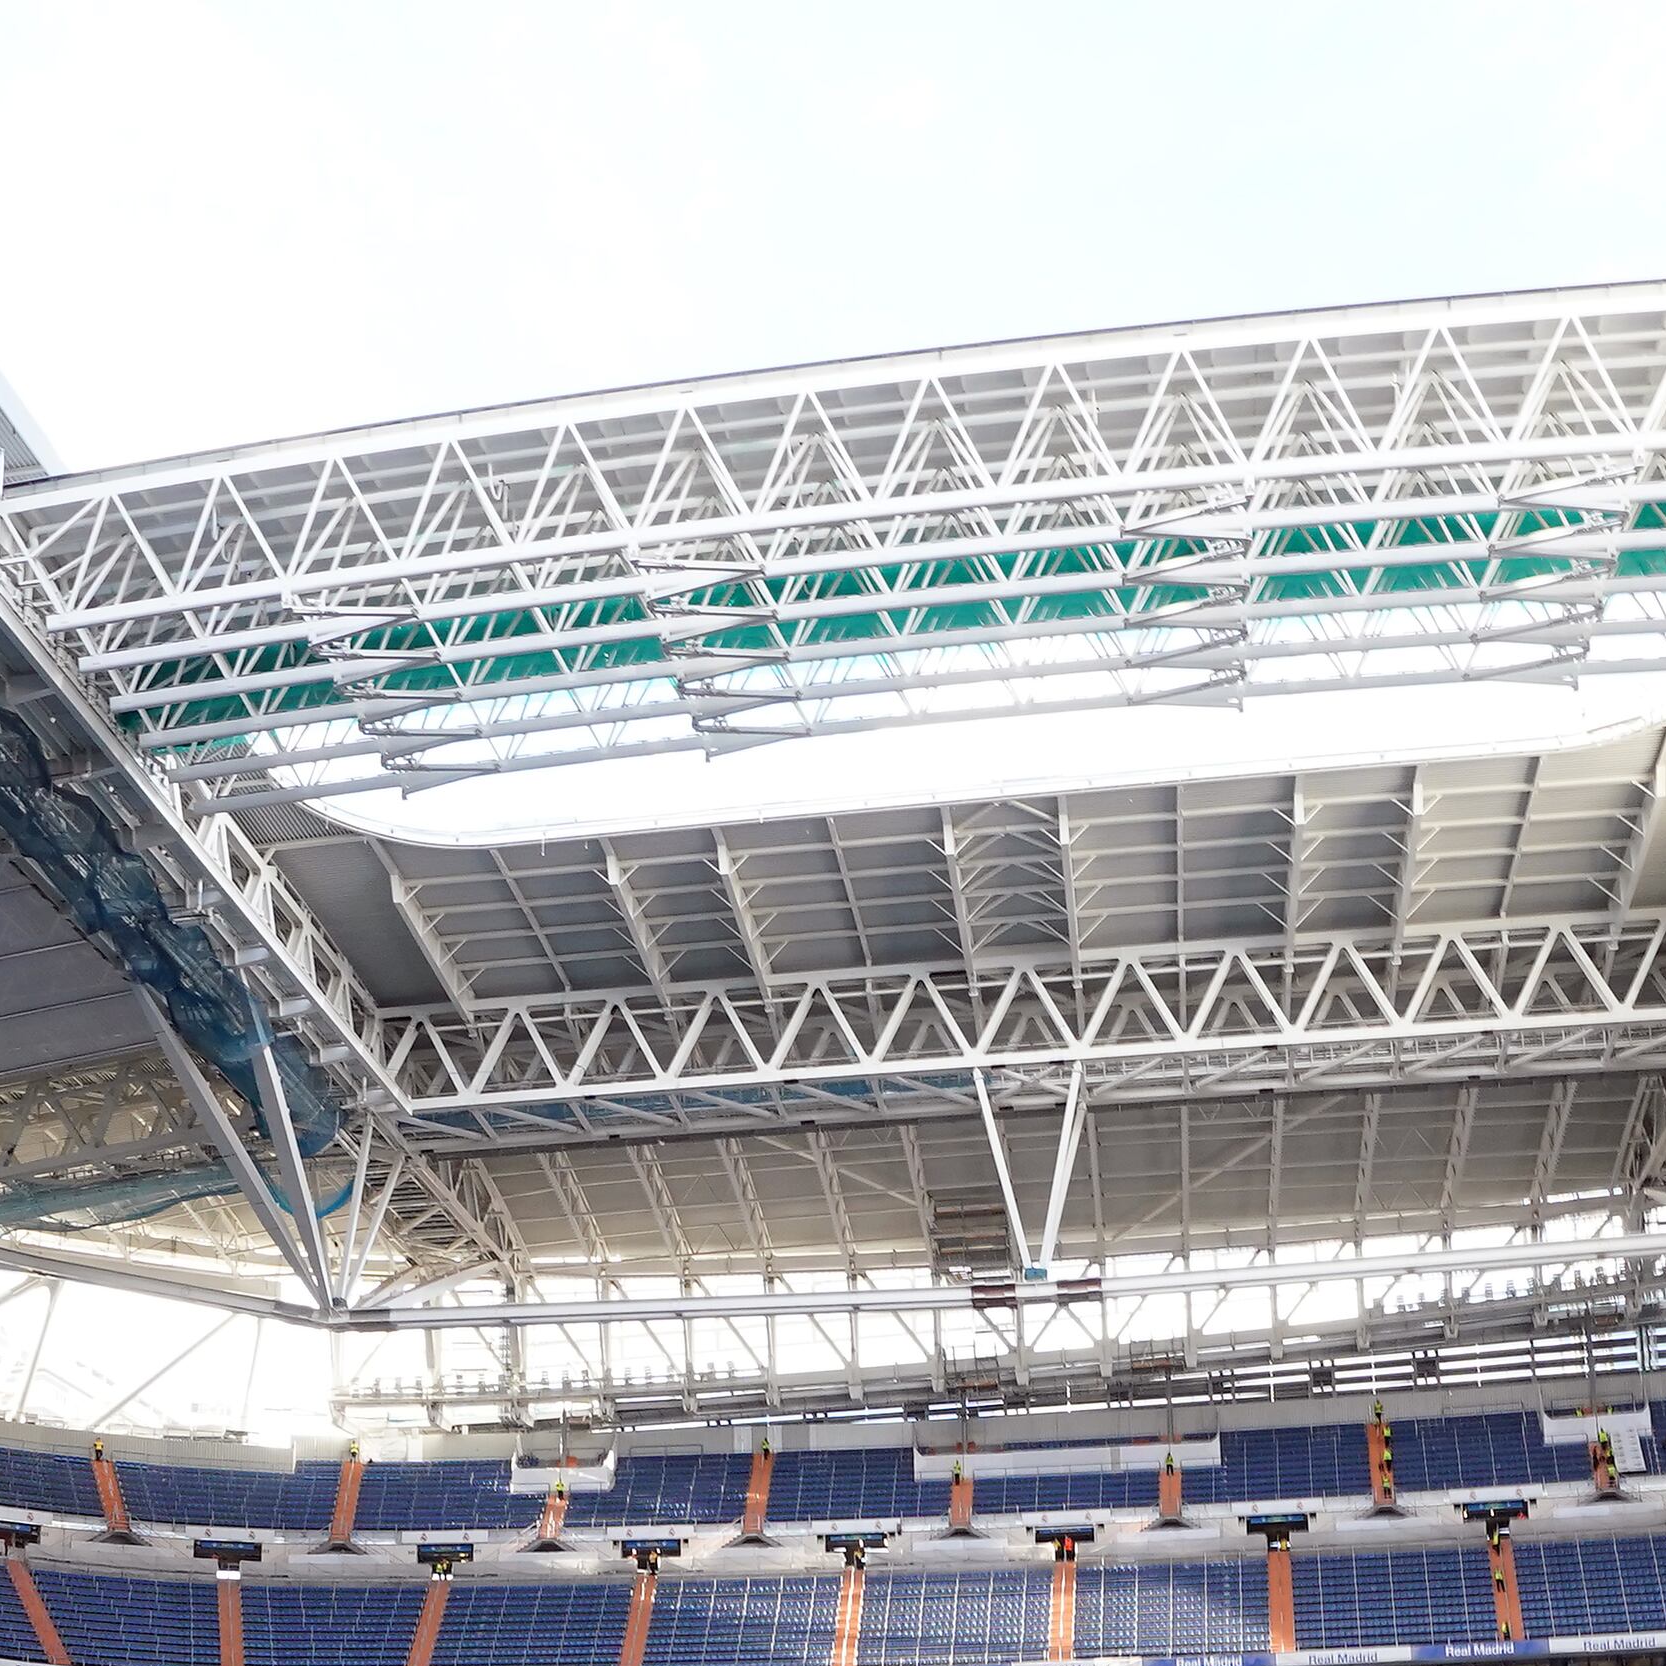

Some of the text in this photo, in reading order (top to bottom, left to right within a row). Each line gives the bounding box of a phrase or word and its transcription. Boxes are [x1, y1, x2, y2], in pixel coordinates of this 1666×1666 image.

[1445, 1643, 1514, 1657] Real Madrid
[1583, 1637, 1656, 1651] Real Madrid
[1308, 1651, 1378, 1664] Real Madrid
